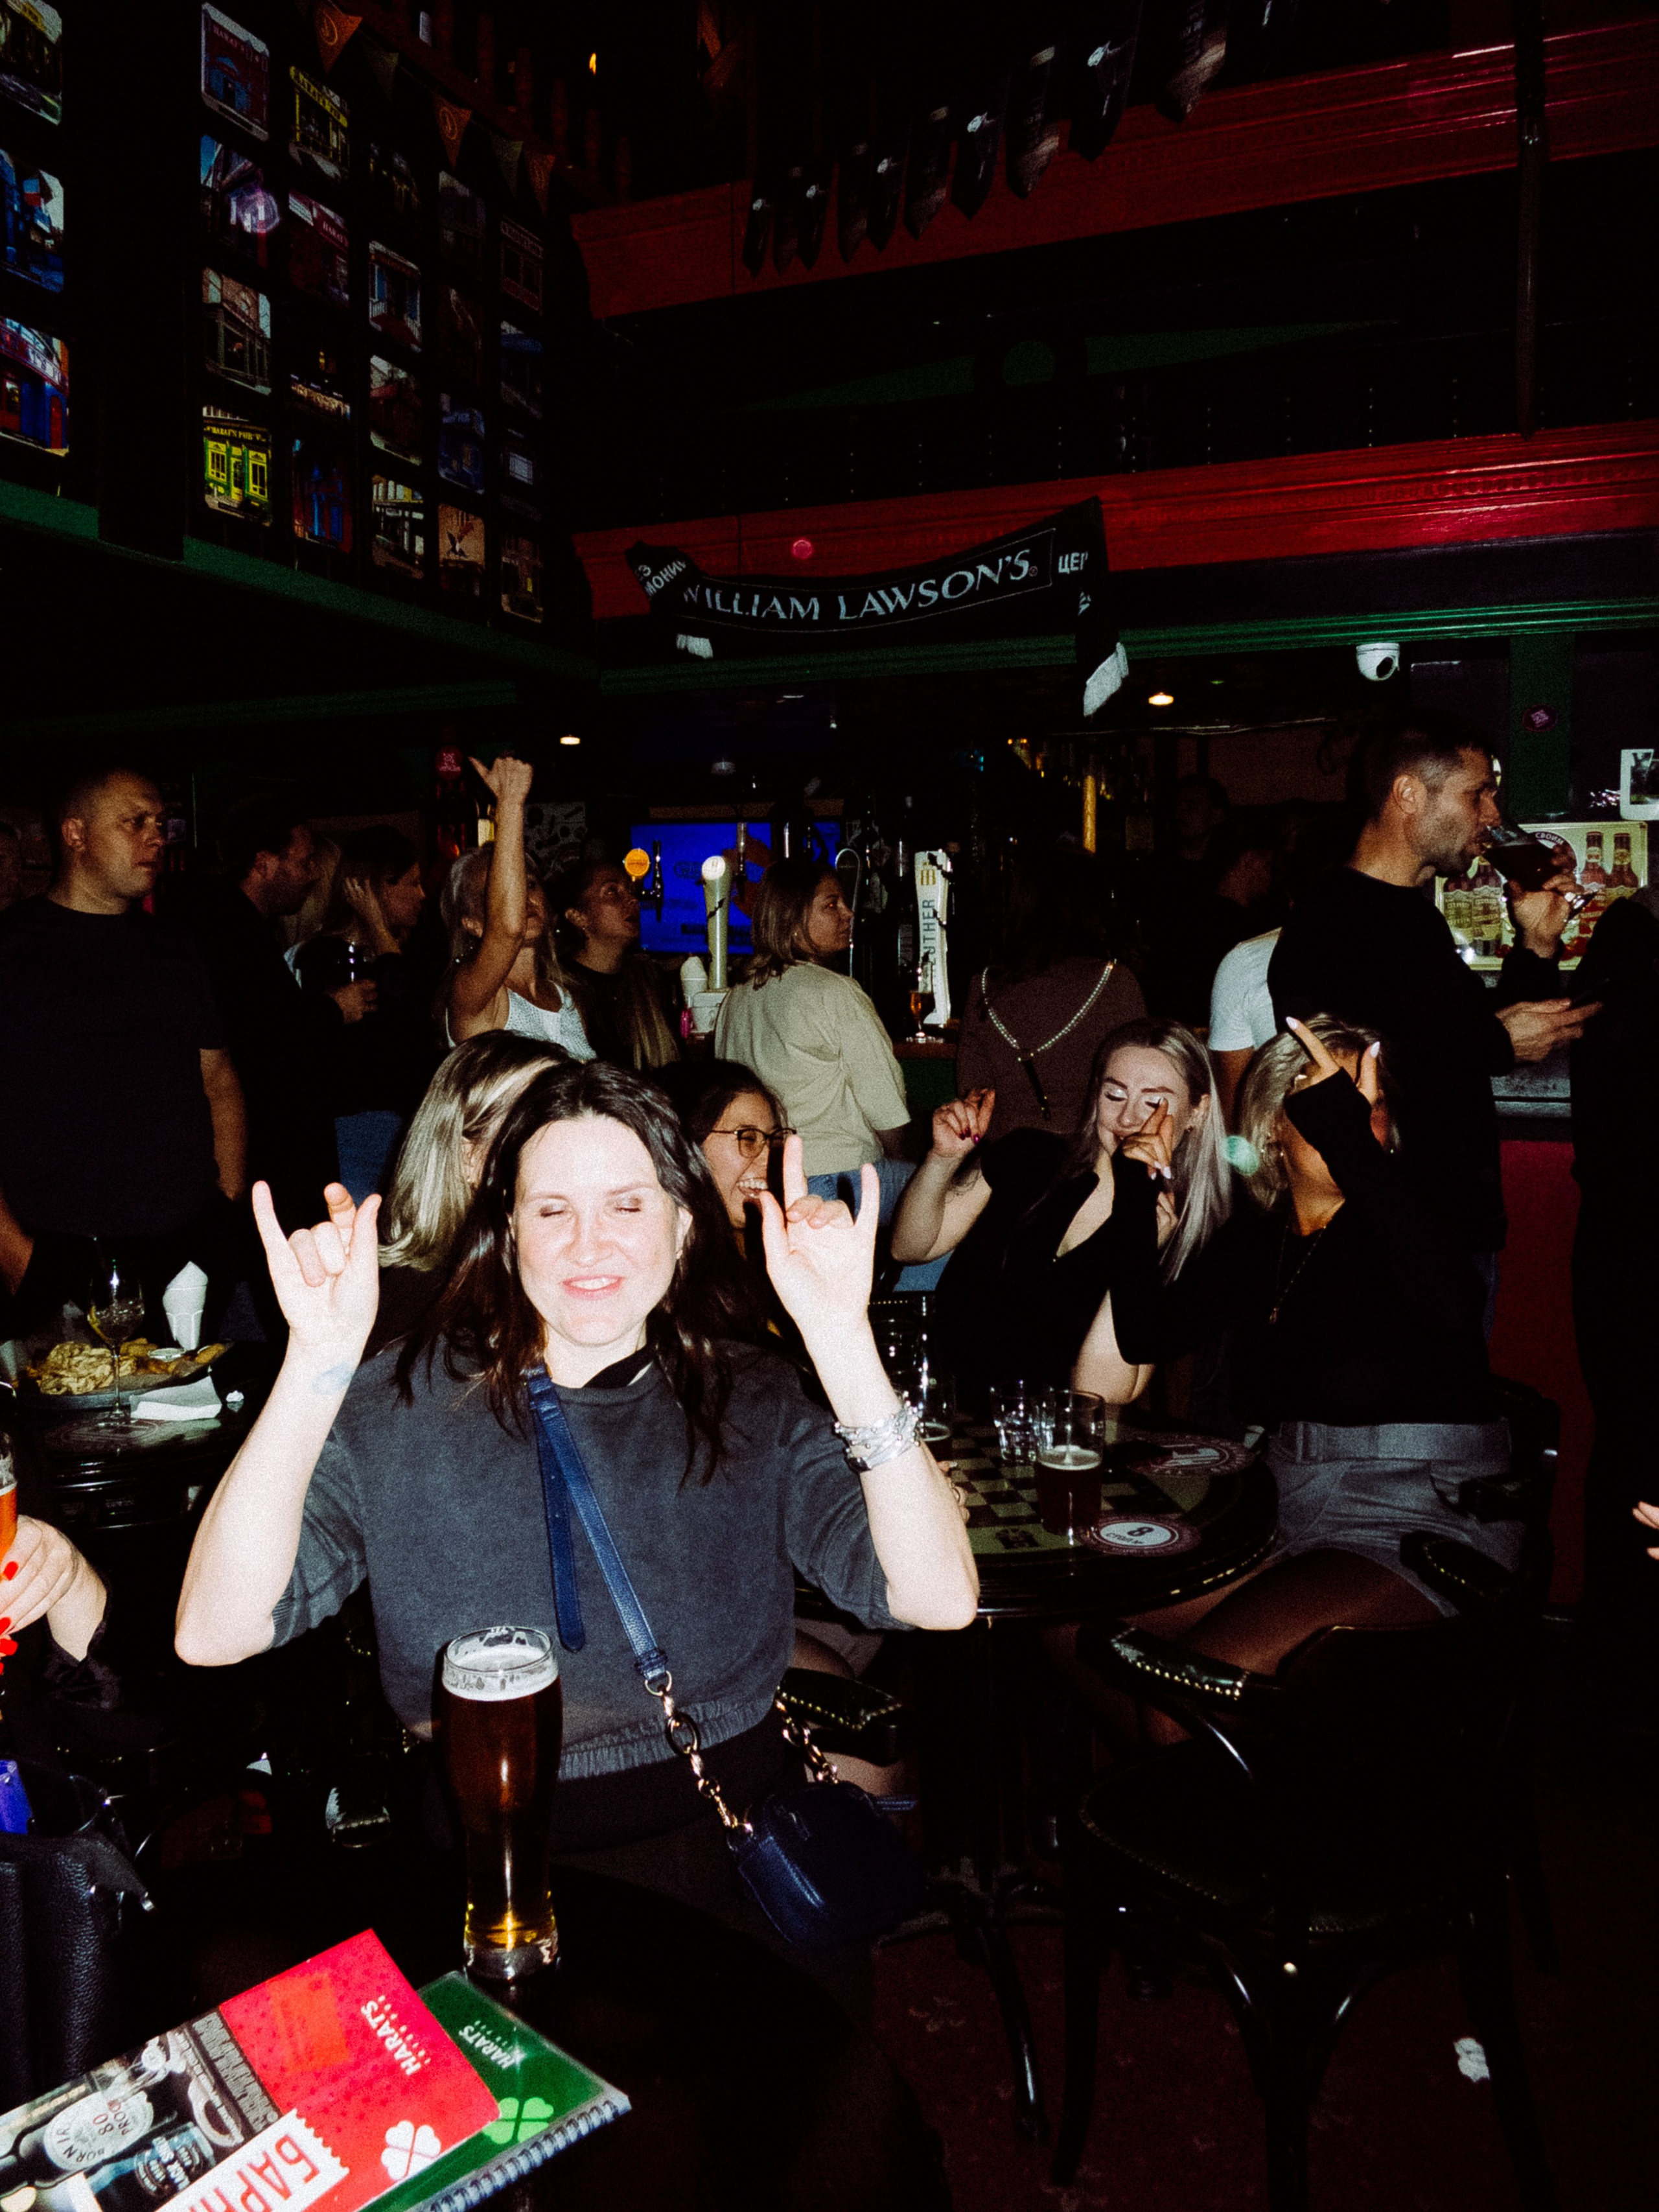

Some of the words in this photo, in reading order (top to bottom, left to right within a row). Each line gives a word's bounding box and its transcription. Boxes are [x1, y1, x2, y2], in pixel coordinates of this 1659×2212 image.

[682, 584, 820, 620] WILLIAM
[837, 548, 1030, 620] LAWSON'S
[1127, 1526, 1154, 1537] 8
[360, 2000, 422, 2076] HARATS
[458, 2025, 516, 2069] HARATS
[189, 2135, 320, 2212] БАР
